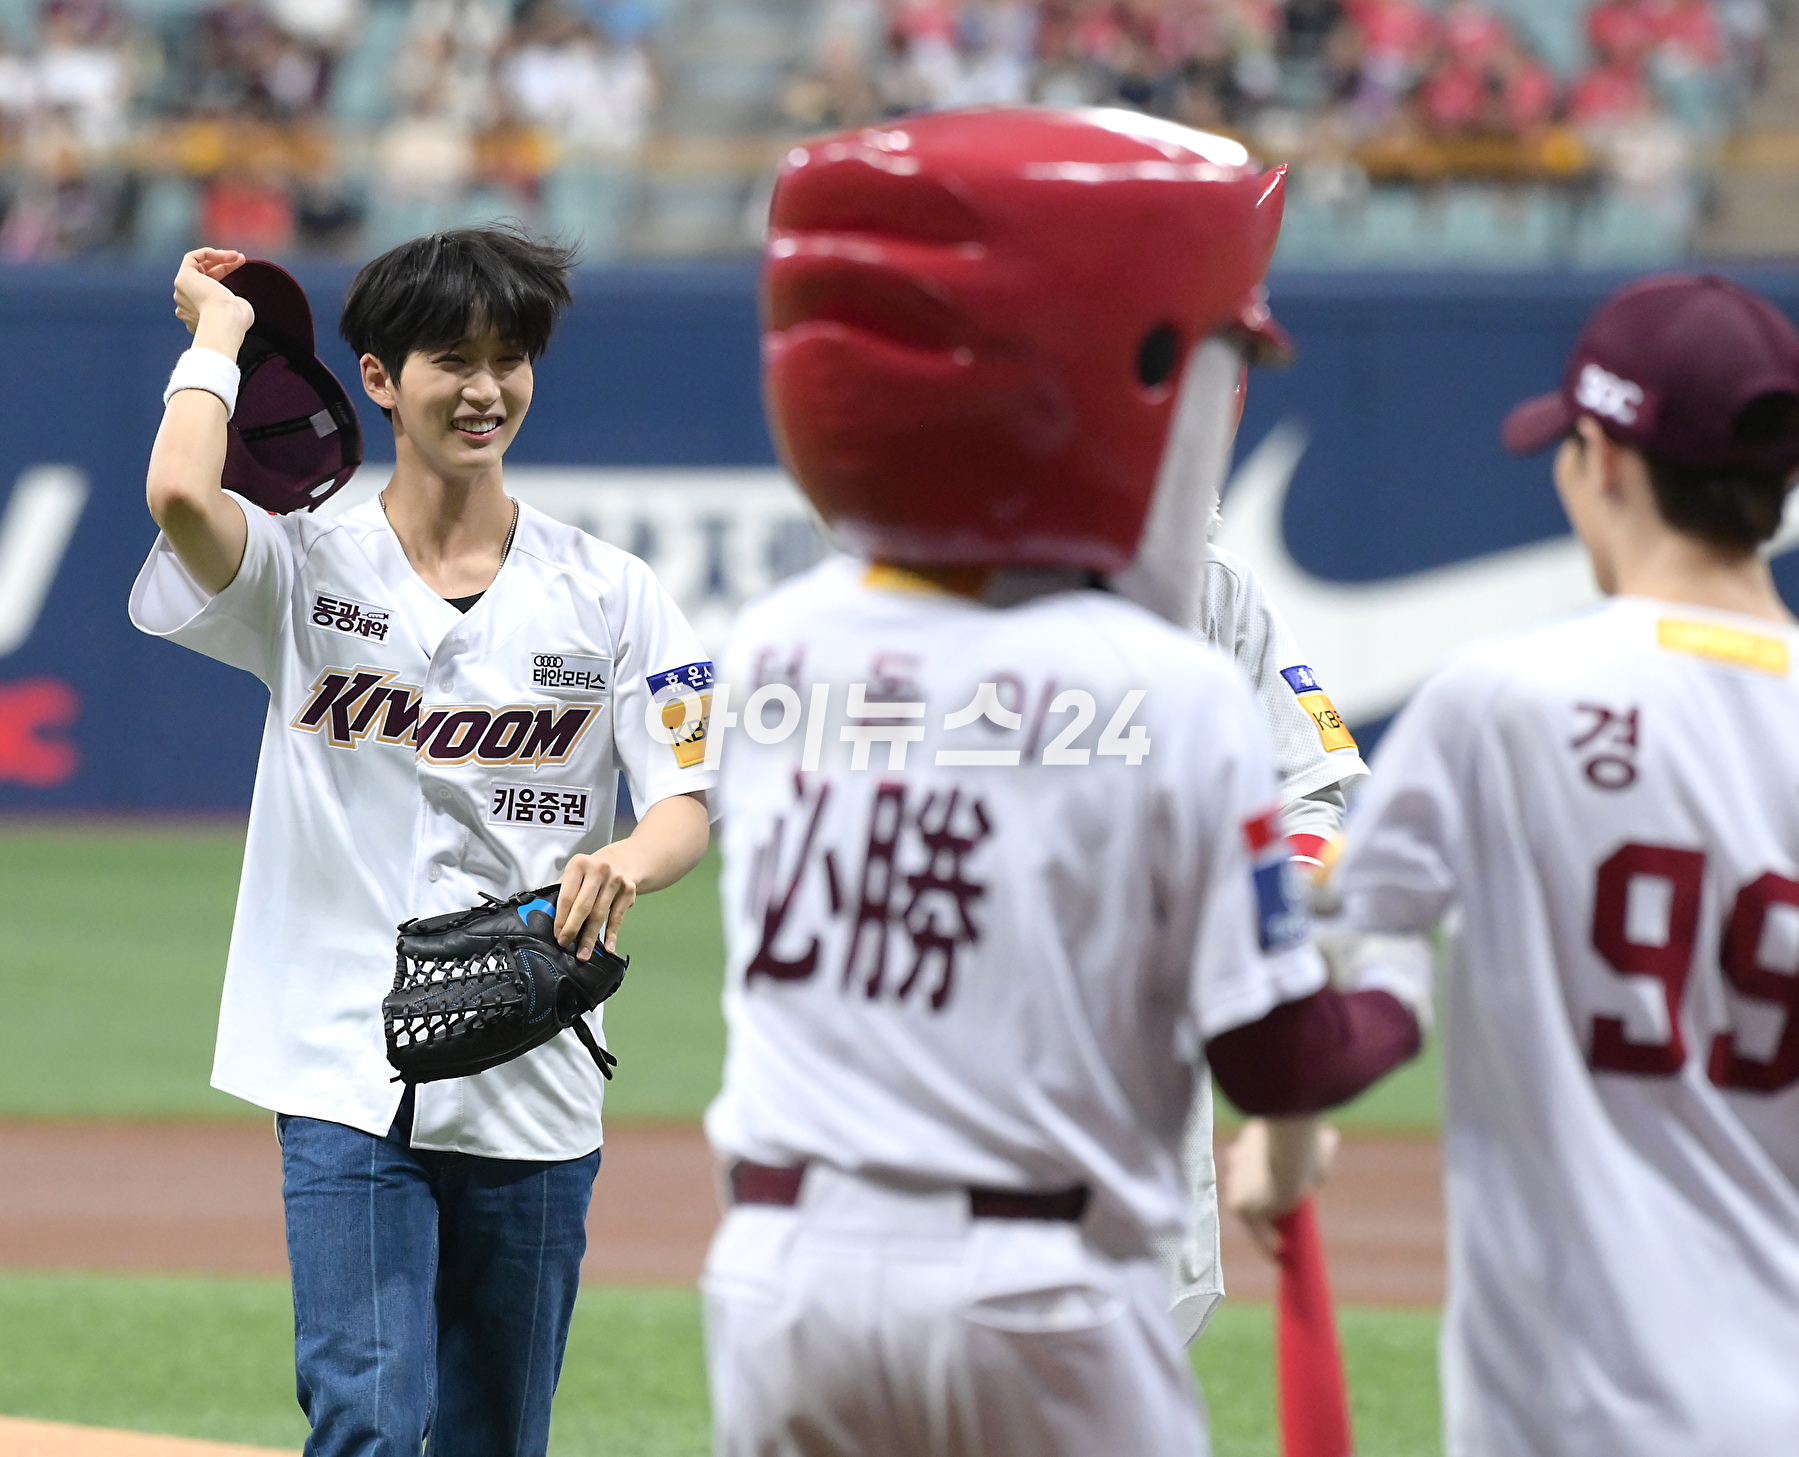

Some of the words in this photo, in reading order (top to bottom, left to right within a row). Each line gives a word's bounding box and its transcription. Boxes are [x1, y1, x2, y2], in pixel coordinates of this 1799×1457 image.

[312, 595, 389, 641] 동광제약
[533, 667, 606, 691] 태안모터스
[298, 669, 597, 764] KIWOOM
[492, 787, 586, 827] 키움증권
[1589, 842, 1799, 1093] 99
